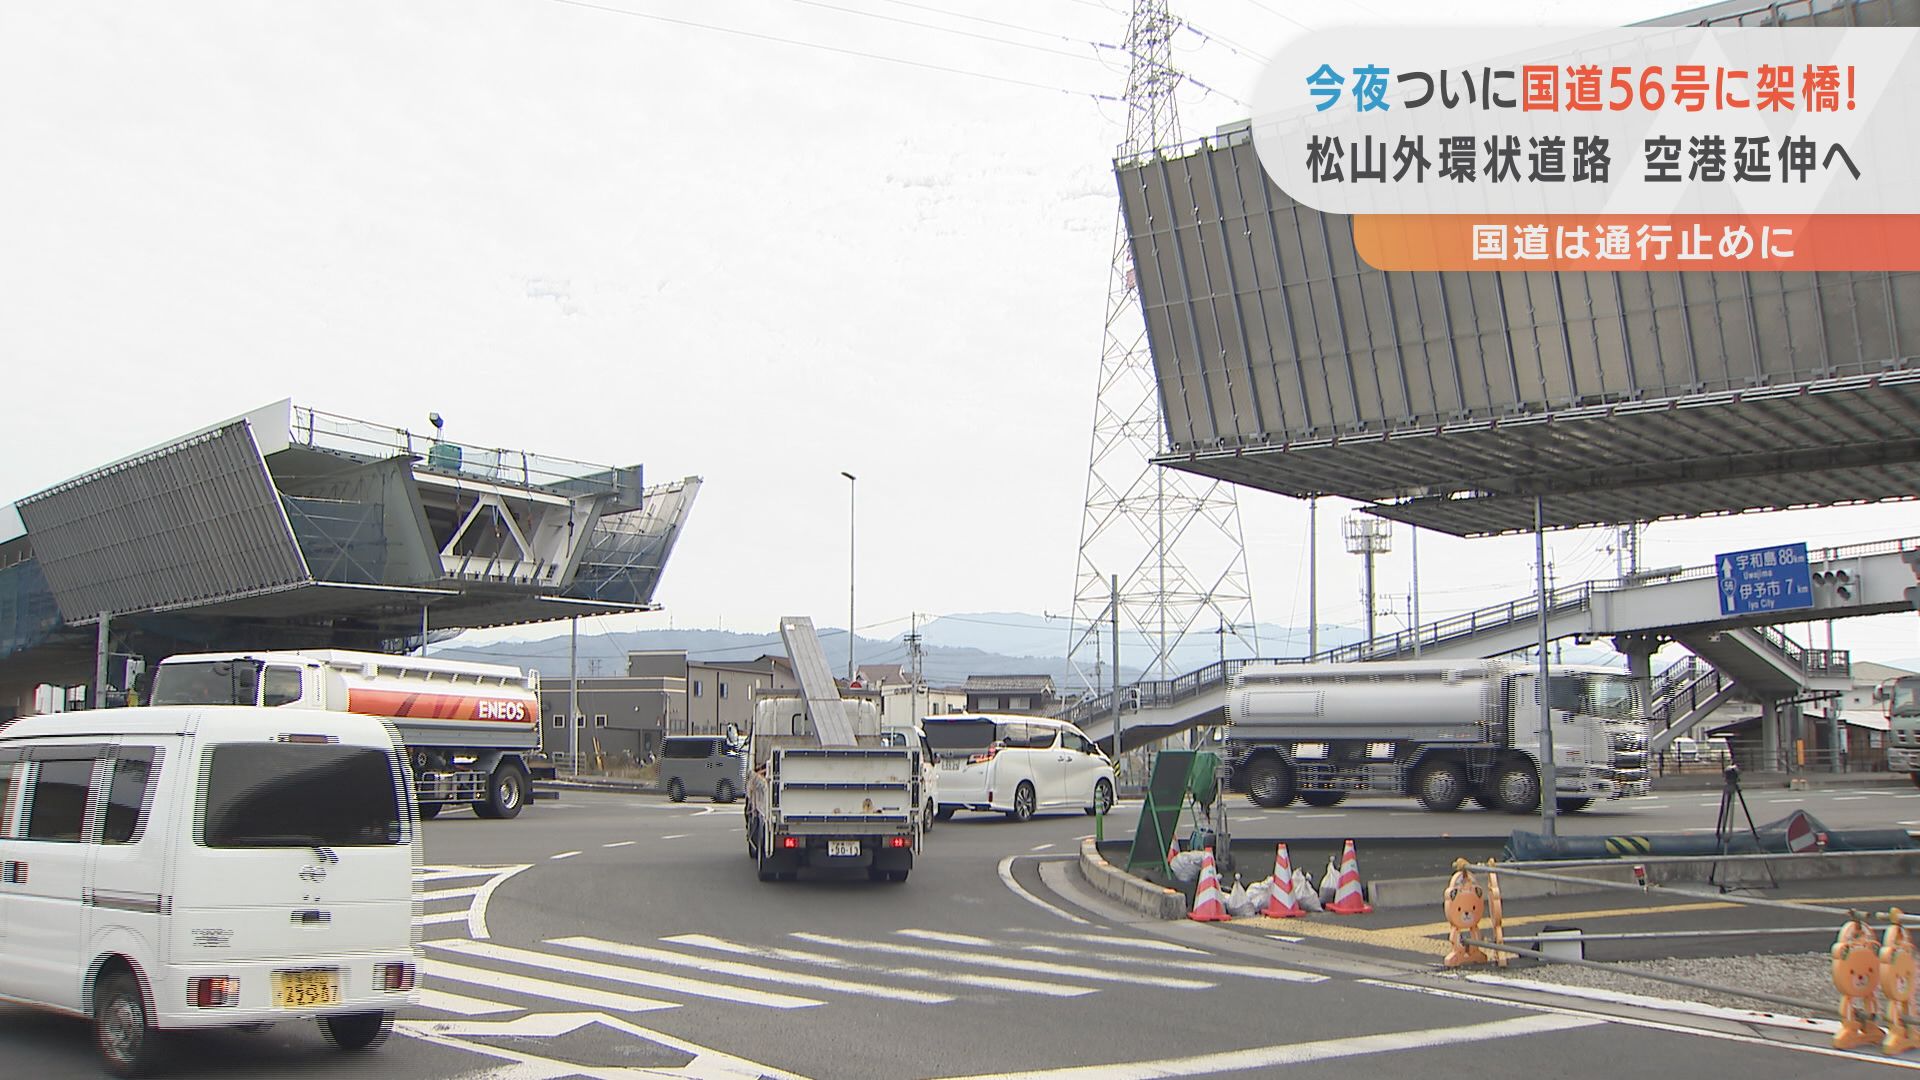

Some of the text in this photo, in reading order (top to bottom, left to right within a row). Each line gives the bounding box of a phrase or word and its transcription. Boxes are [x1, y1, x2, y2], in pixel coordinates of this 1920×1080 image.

[1736, 551, 1777, 570] 宇和島
[1740, 581, 1780, 600] 伊予市
[478, 700, 524, 721] ENEOS
